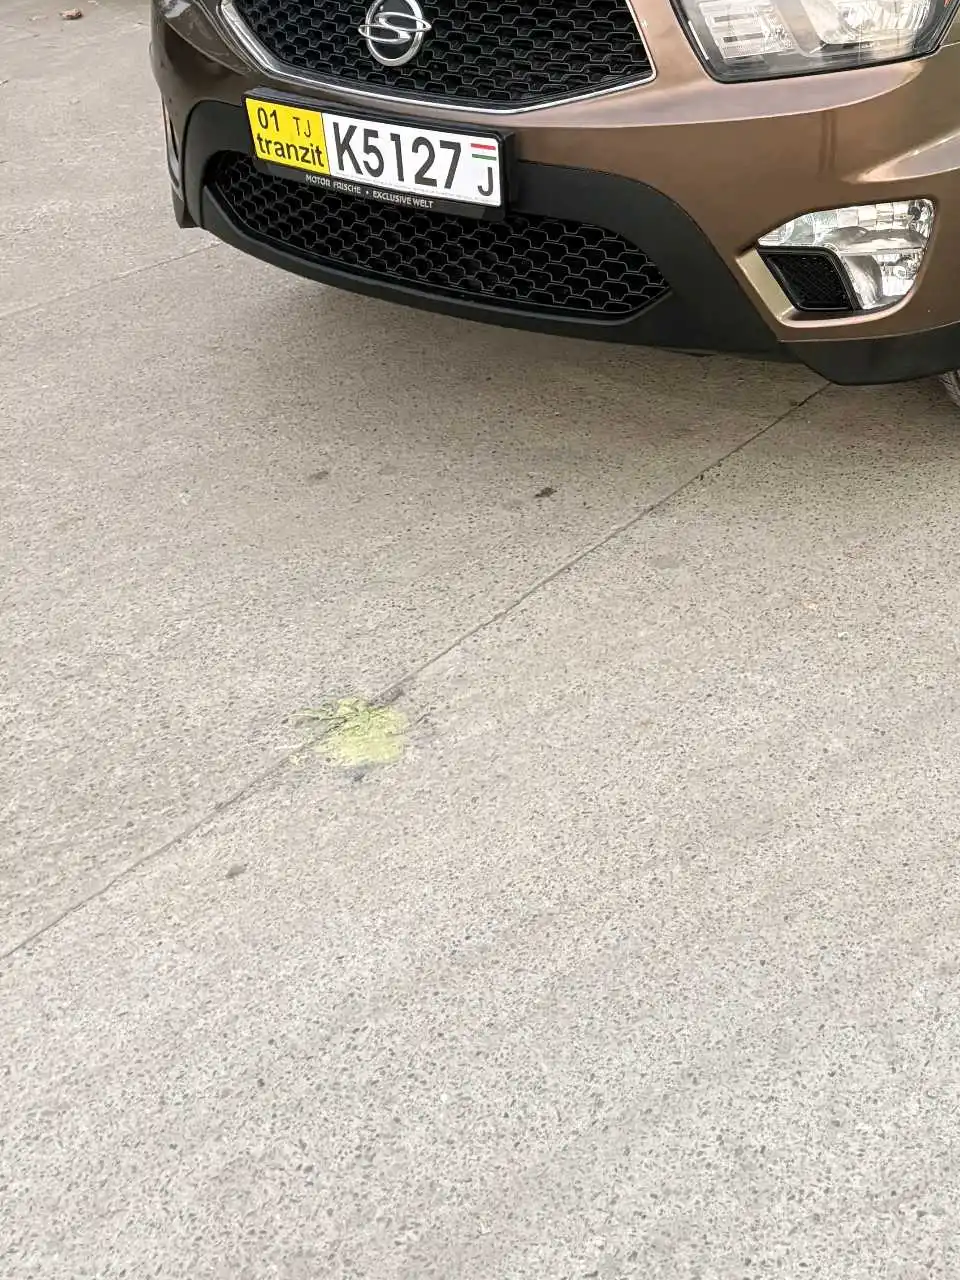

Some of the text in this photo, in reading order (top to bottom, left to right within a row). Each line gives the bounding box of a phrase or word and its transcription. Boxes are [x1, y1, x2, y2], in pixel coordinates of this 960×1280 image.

[257, 106, 312, 138] 01 TJ
[256, 132, 325, 168] tranzit
[332, 122, 462, 190] K5127
[305, 174, 331, 188] MOTOR
[372, 190, 412, 205] EXCLUSIVE
[412, 198, 434, 209] WELT
